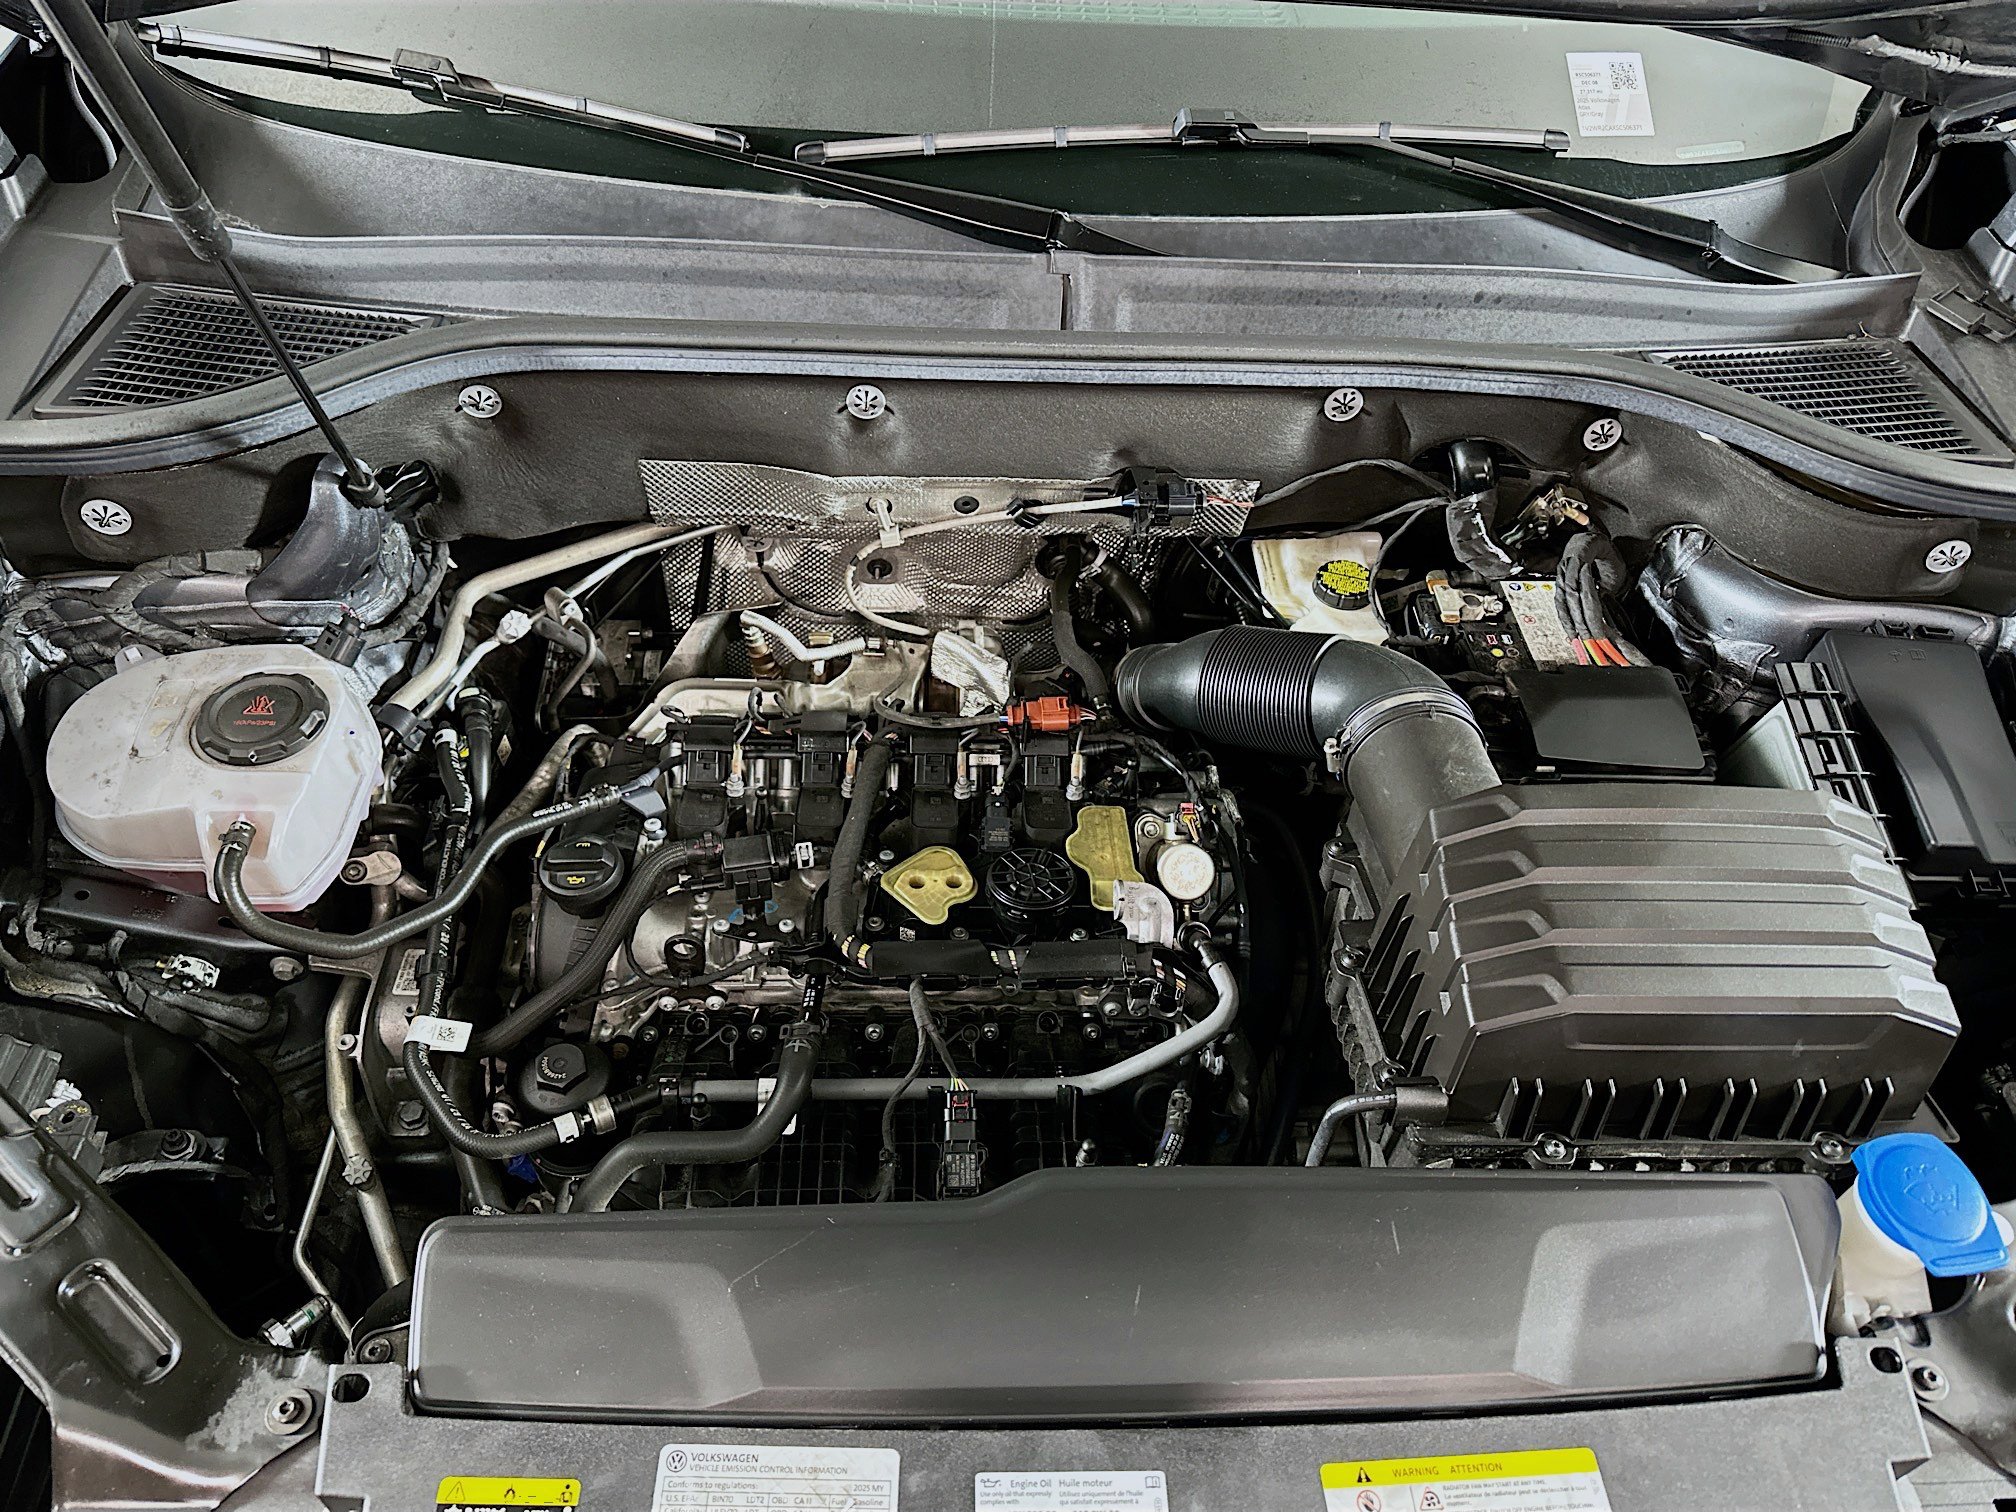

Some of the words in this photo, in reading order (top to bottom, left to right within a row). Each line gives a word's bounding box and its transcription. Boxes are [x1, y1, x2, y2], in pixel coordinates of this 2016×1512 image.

[691, 1452, 761, 1463] VOLKSWAGEN
[690, 1464, 719, 1472] VEHICLE
[721, 1465, 757, 1473] EMISSION
[760, 1465, 793, 1474] CONTROL
[795, 1466, 848, 1474] INFORMATION
[1392, 1466, 1440, 1477] WARNING
[1450, 1462, 1503, 1474] ATTENTION
[668, 1480, 704, 1489] Conforms
[705, 1481, 713, 1489] to
[853, 1484, 870, 1492] 2025
[1010, 1480, 1038, 1490] Engine
[1059, 1479, 1080, 1487] Huile
[746, 1496, 765, 1504] LDT2
